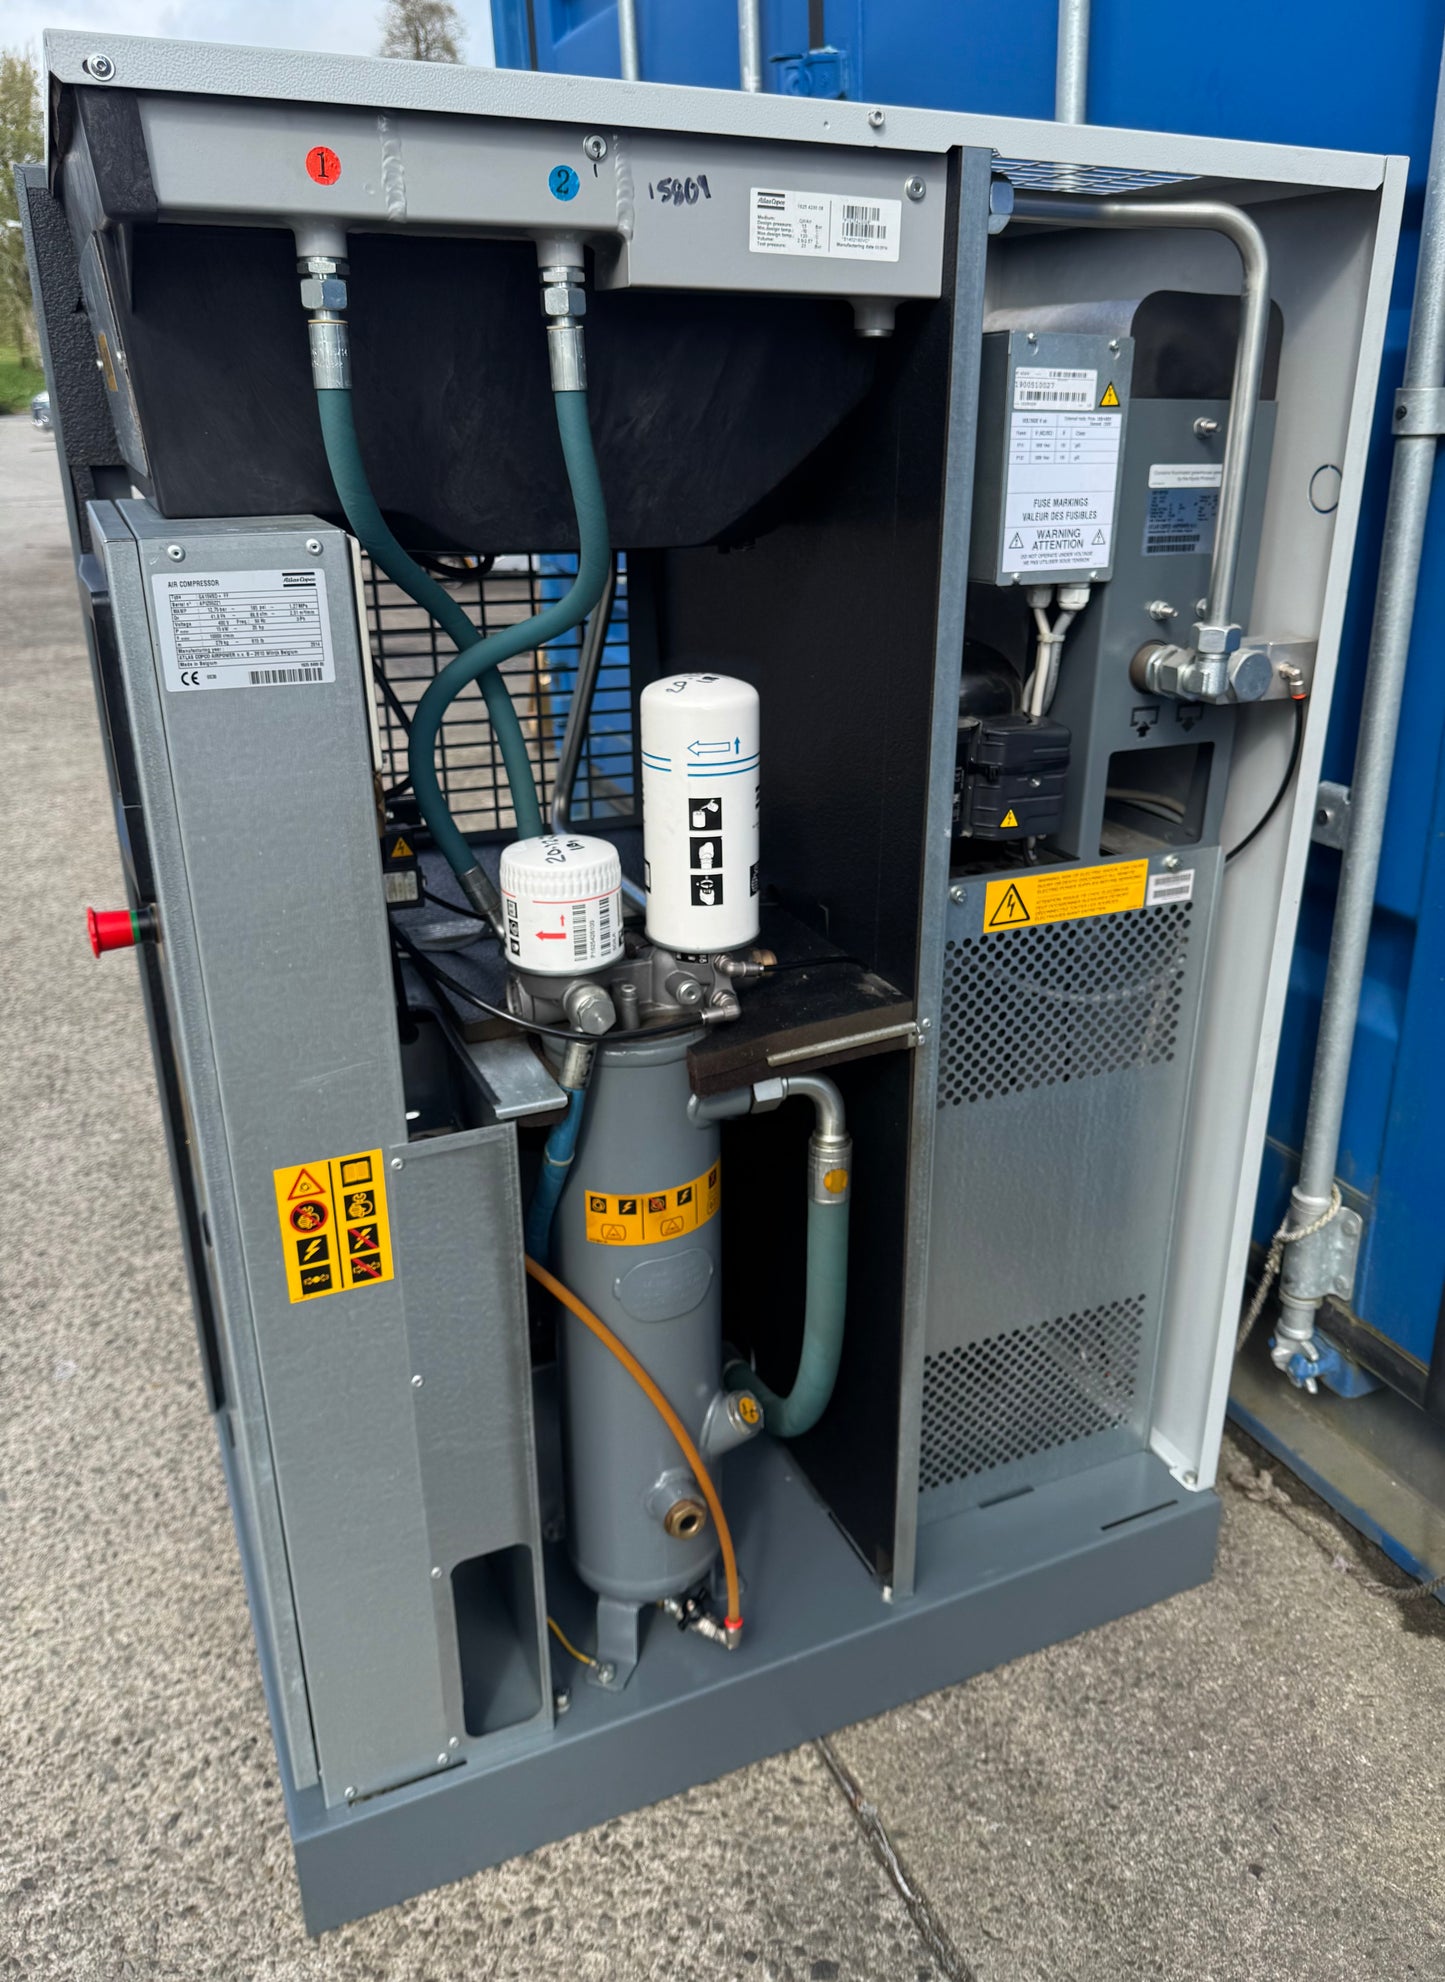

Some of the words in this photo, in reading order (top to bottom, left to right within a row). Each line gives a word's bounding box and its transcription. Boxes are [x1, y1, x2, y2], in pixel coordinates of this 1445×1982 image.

[316, 152, 331, 178] 1
[556, 168, 571, 195] 2
[1033, 498, 1051, 508] FUSE
[1053, 498, 1088, 507] MARKINGS
[1023, 512, 1049, 521] VALEUR
[1051, 511, 1064, 521] DES
[1066, 510, 1097, 520] FUSIBLES
[1037, 529, 1081, 539] WARNING
[1032, 540, 1084, 550] ATTENTION
[180, 579, 220, 587] COMPRESSOR
